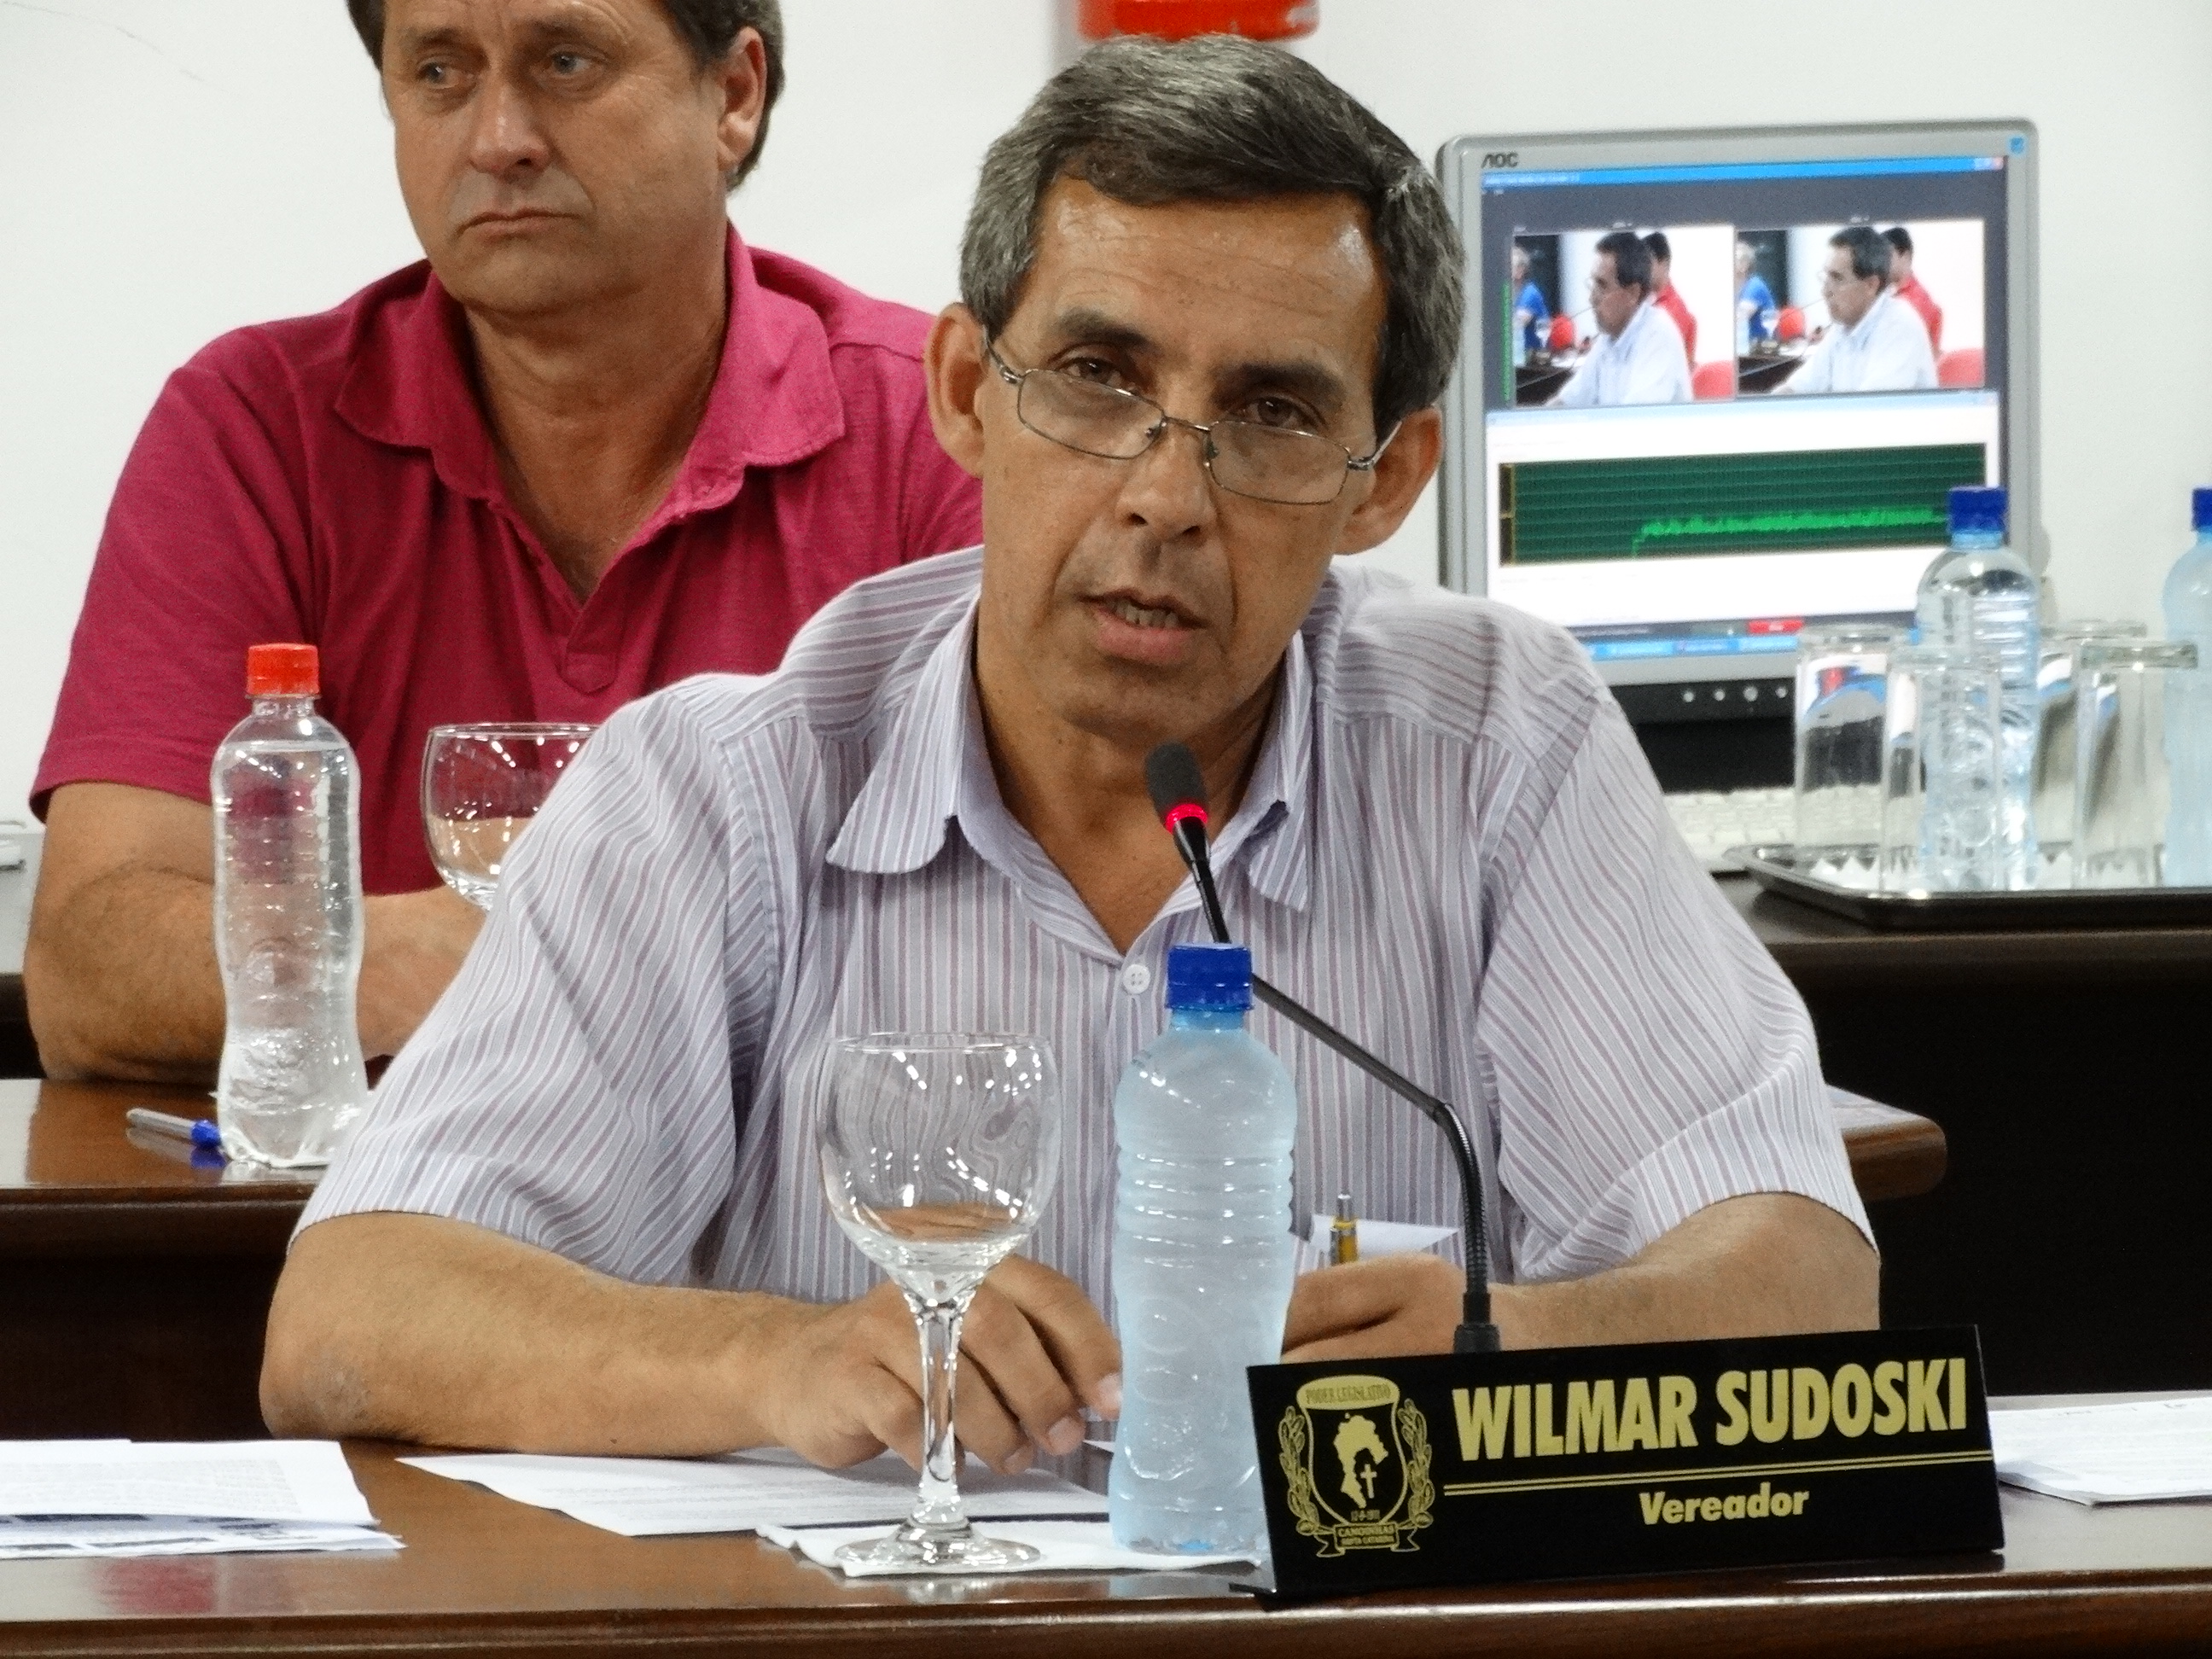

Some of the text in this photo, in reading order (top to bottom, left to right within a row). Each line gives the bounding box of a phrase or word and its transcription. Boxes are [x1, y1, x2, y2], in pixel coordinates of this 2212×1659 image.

[1481, 151, 1519, 169] AOC
[1452, 1358, 1966, 1462] WILMAR SUDOSKI
[1639, 1481, 1809, 1525] Vereador
